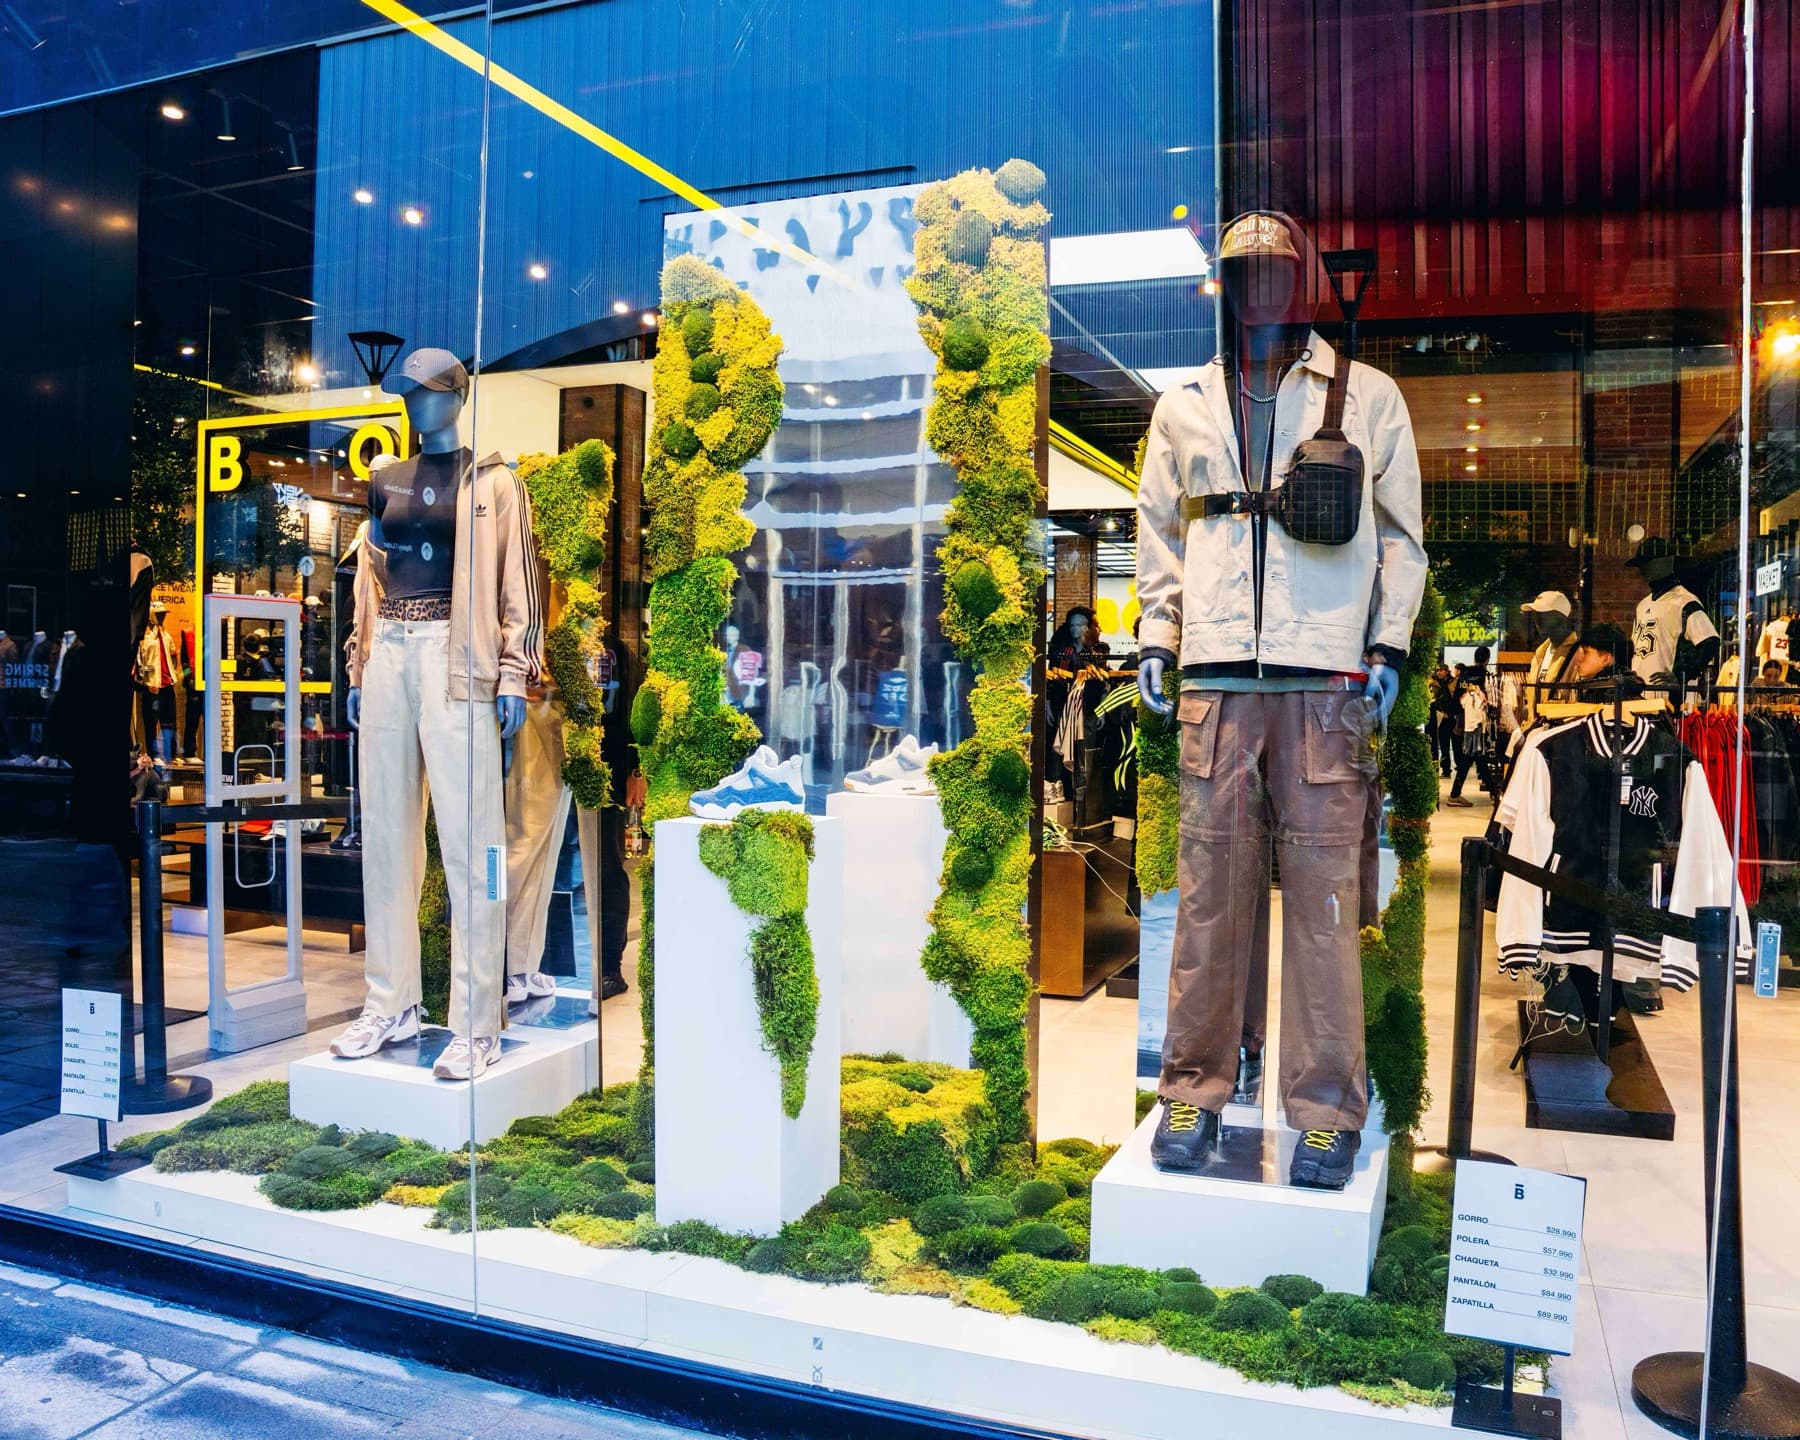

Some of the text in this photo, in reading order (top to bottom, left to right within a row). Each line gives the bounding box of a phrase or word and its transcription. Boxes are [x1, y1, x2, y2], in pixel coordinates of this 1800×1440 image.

[1232, 218, 1279, 236] Call My
[1231, 233, 1278, 249] Lawyer
[209, 435, 243, 492] B
[1758, 568, 1780, 588] MARKET
[1444, 628, 1470, 642] TOUR
[1775, 638, 1788, 650] 23
[1629, 786, 1659, 818] NY
[1457, 1213, 1577, 1239] GORRO $28.990
[1456, 1234, 1573, 1259] POLERA $57.990
[1454, 1254, 1574, 1280] CHAQUETA $32.990
[1453, 1275, 1571, 1301] PANTALÓN $84.990
[1451, 1296, 1568, 1322] ZAPATILLA $89.990
